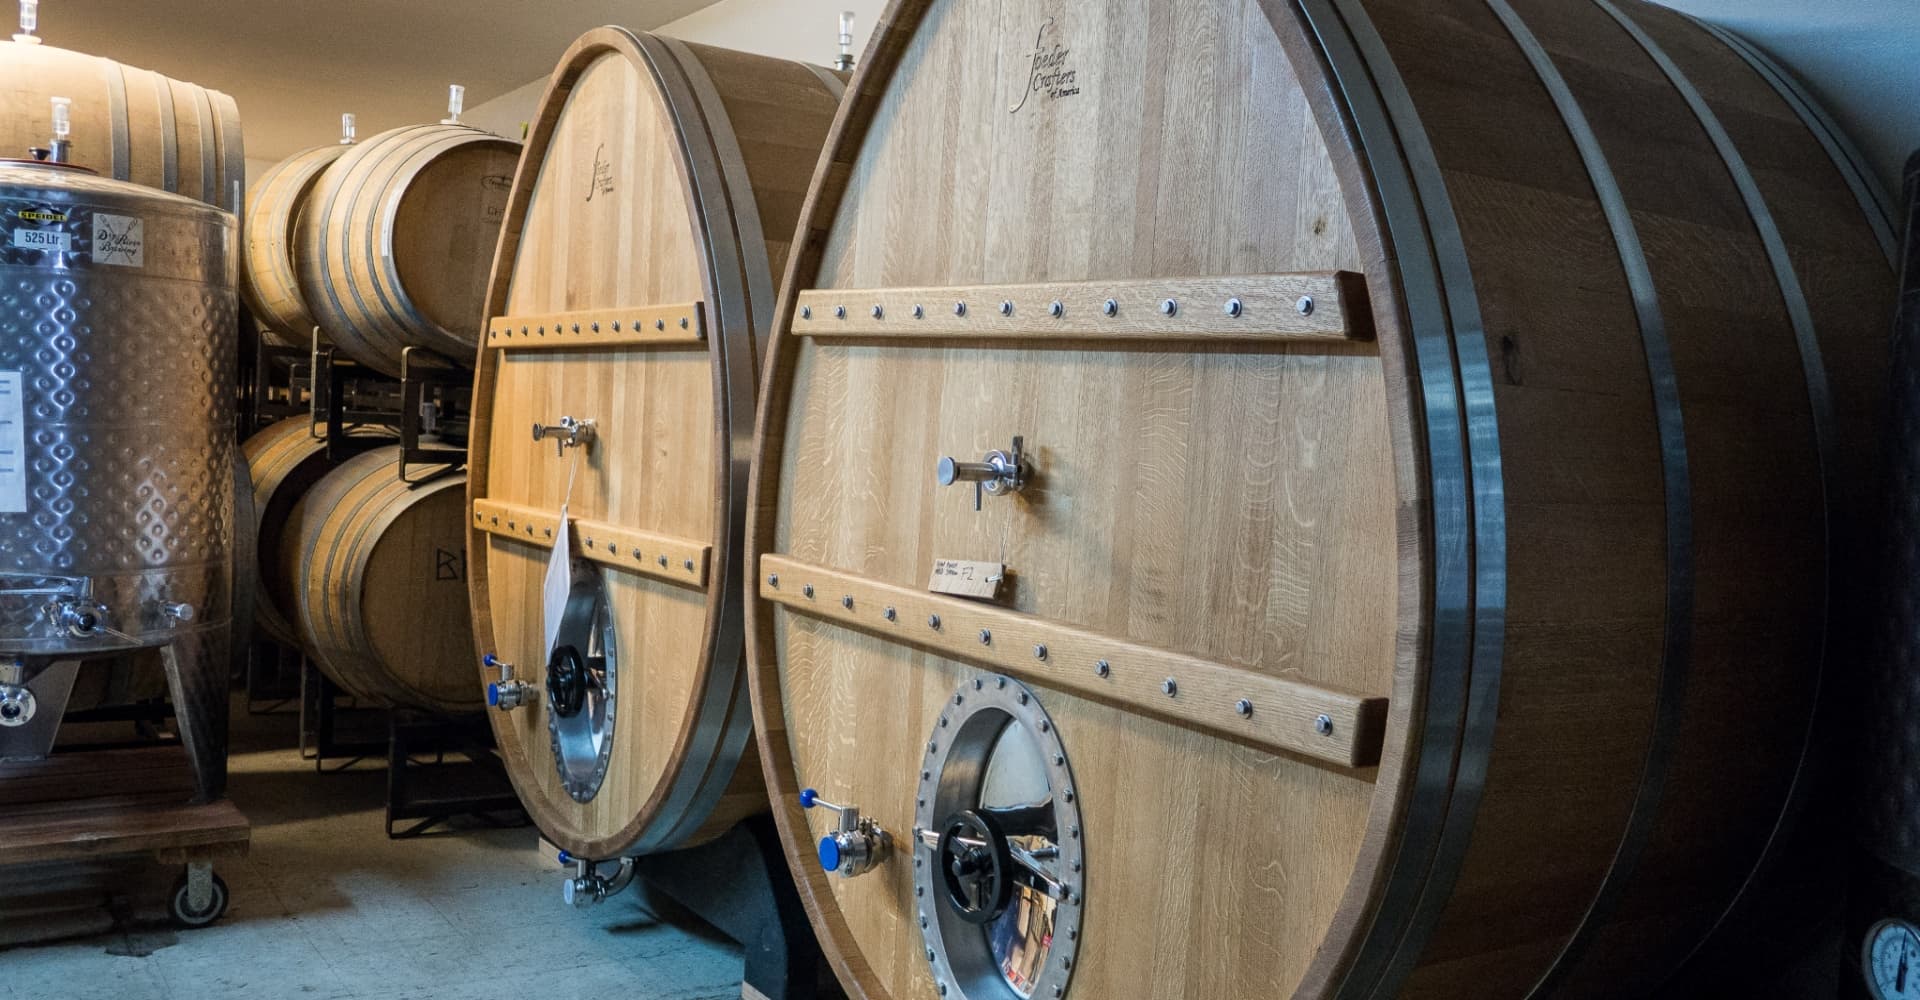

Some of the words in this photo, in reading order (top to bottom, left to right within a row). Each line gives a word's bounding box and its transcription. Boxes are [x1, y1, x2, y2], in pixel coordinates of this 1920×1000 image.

[1033, 67, 1076, 93] Crafters
[20, 212, 65, 221] SPEIDEL
[25, 232, 44, 243] 525
